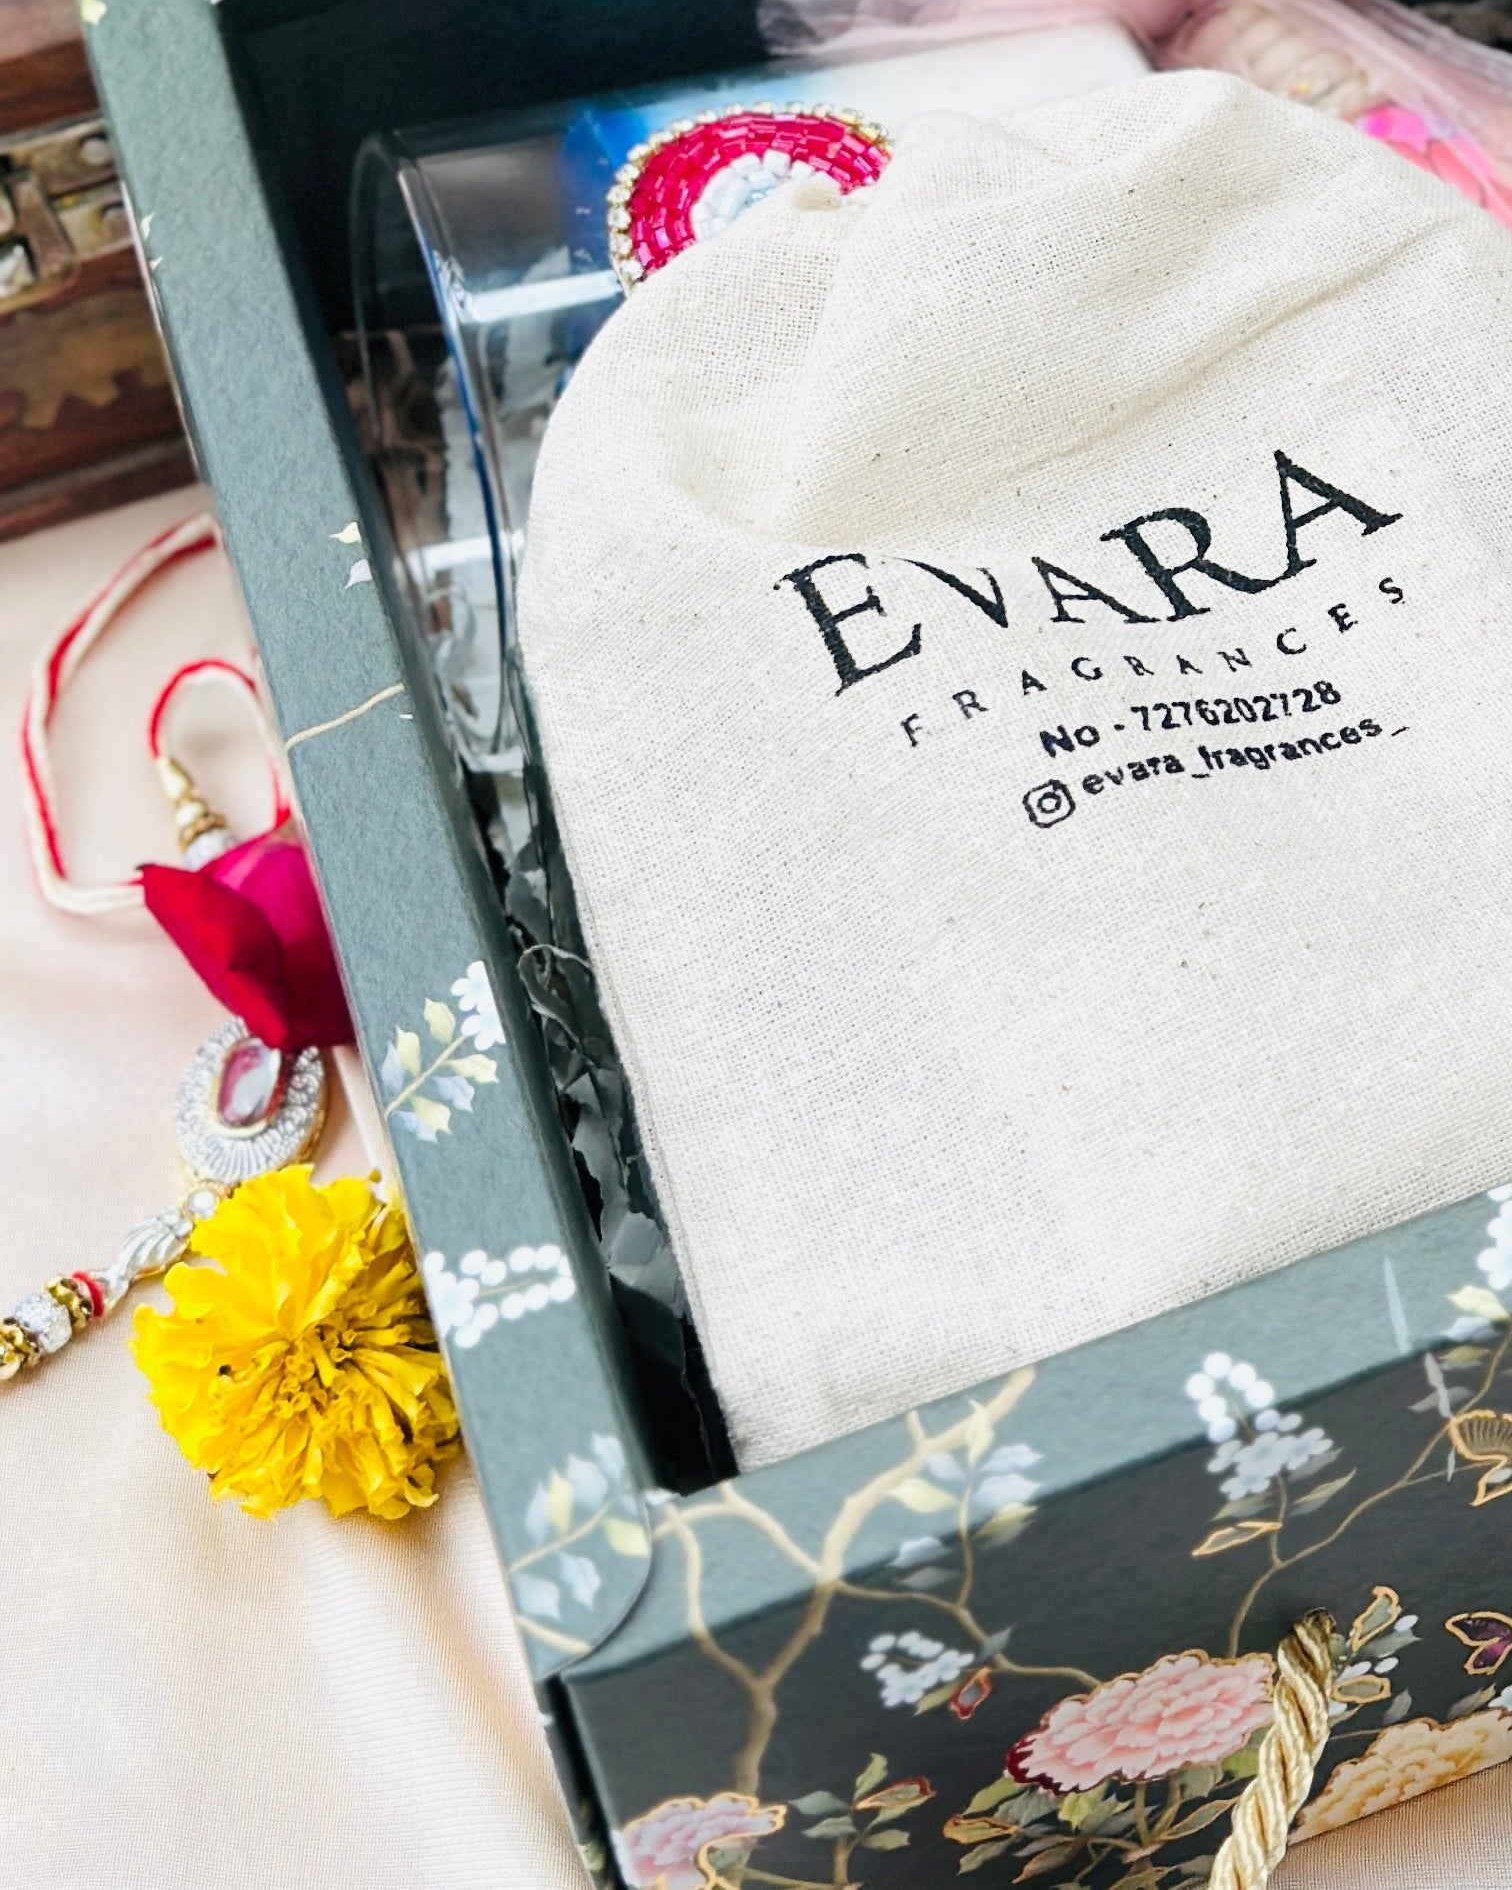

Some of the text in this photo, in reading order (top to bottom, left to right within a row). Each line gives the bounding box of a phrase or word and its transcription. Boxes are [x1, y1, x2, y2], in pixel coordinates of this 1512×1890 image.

[773, 450, 1403, 697] EVARA
[901, 577, 1406, 747] FRAGRANCES
[1040, 724, 1100, 758] No
[1130, 680, 1341, 731] 7276202728
